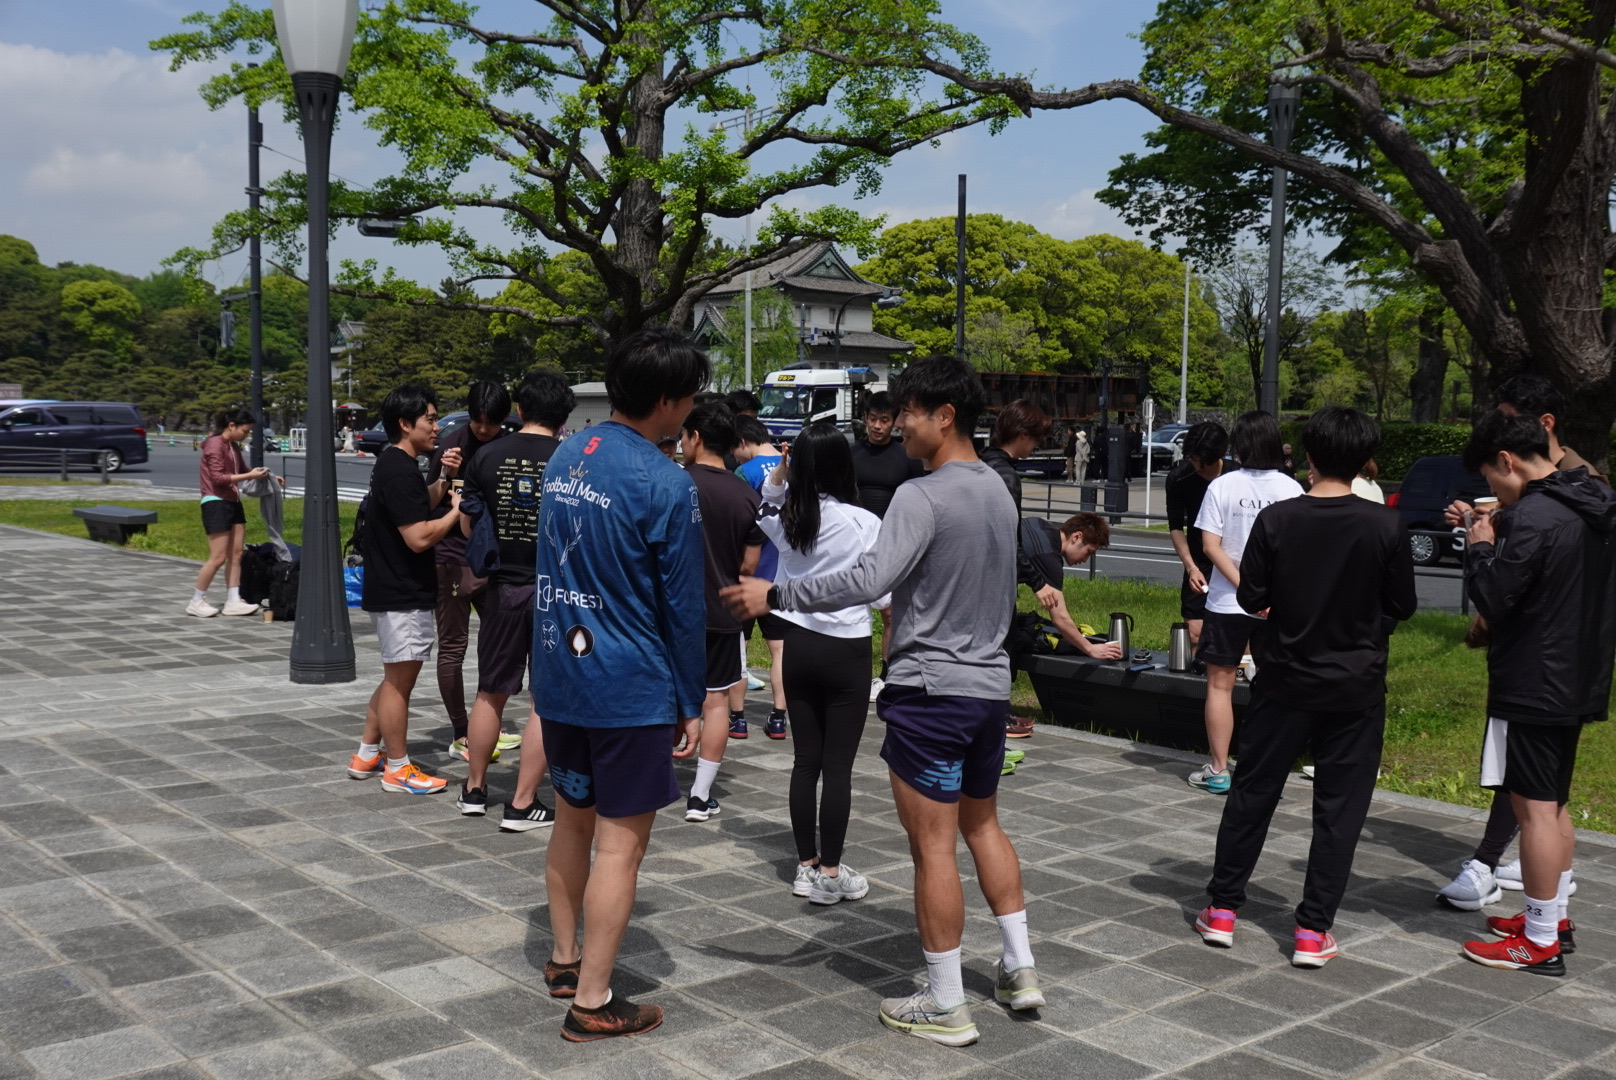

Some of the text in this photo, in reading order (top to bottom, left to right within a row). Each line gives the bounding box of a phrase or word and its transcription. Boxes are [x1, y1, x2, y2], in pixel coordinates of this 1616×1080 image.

[583, 436, 602, 455] 5
[543, 476, 578, 496] Football
[576, 481, 611, 509] Mania
[567, 496, 580, 507] 2022
[555, 588, 603, 610] FOREST
[1526, 904, 1543, 917] 23
[1506, 945, 1533, 963] N
